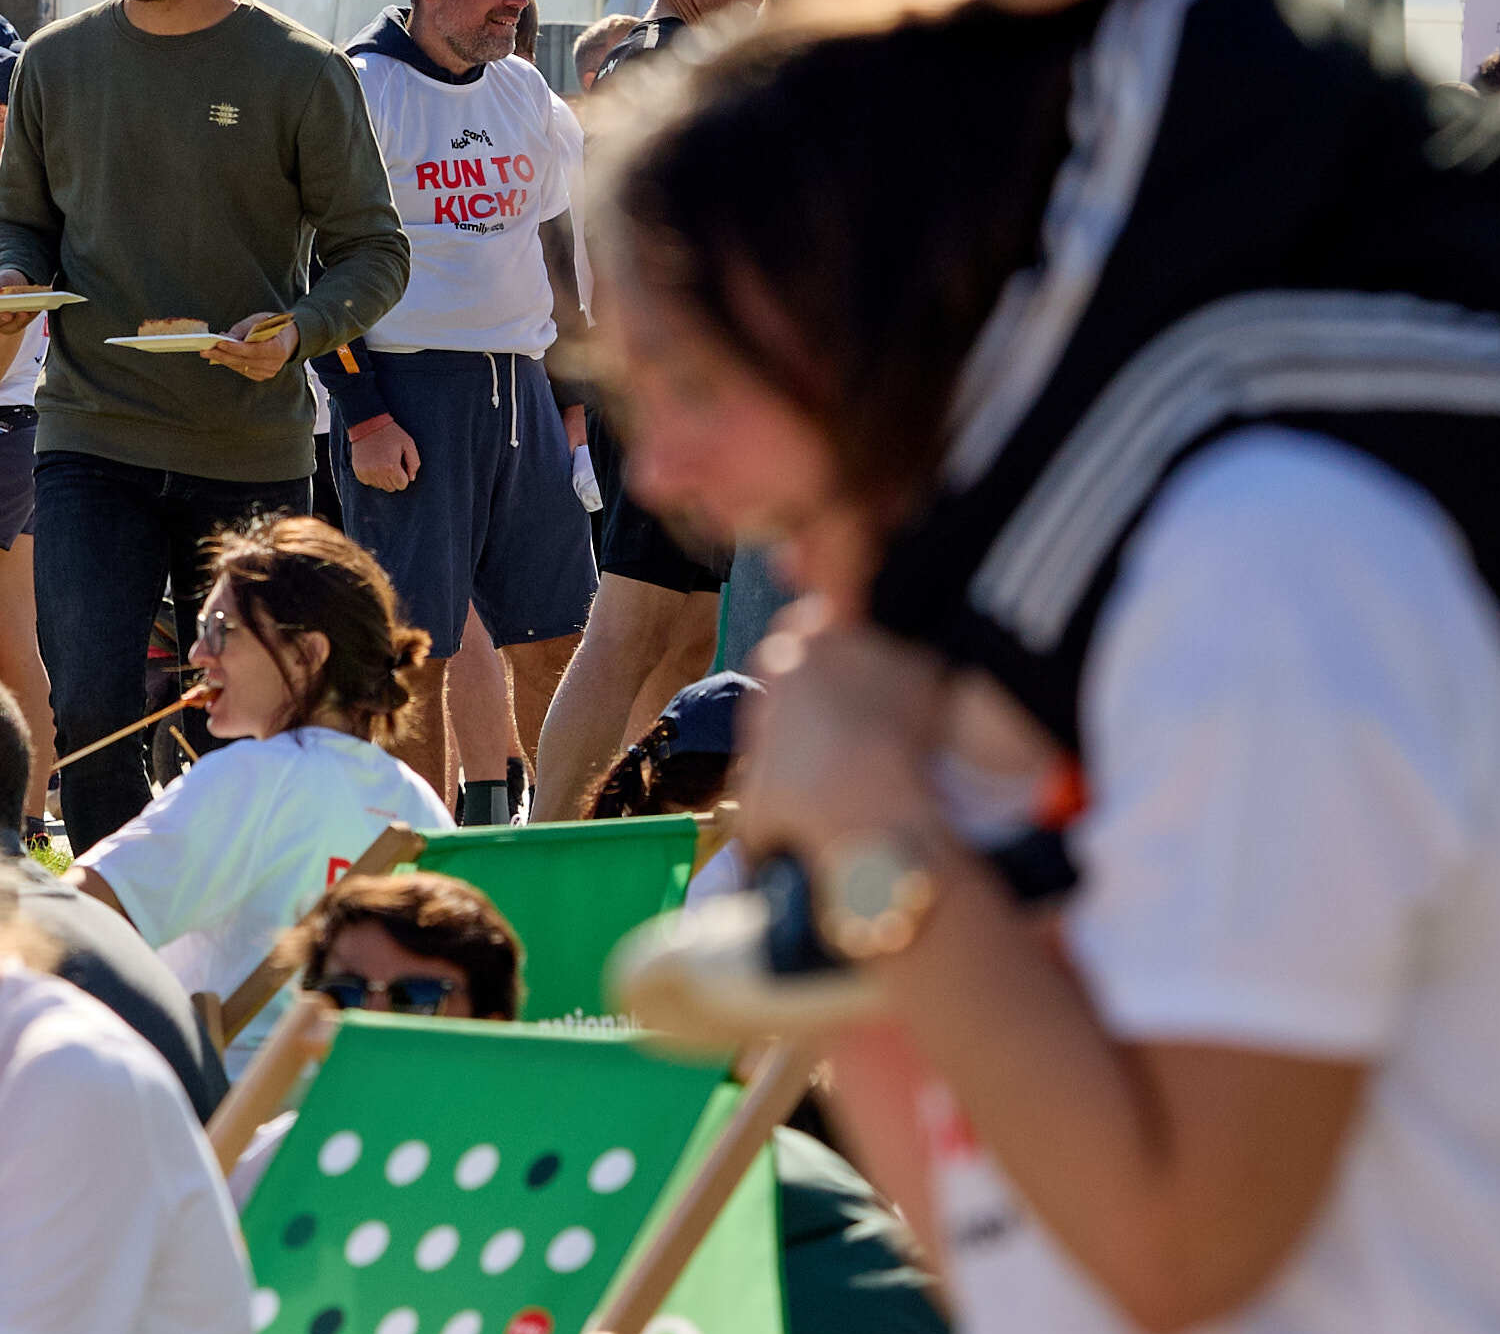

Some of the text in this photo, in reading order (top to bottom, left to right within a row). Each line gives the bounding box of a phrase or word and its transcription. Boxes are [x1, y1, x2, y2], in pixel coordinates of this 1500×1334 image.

[415, 153, 535, 191] RUN TO
[434, 187, 528, 225] KICK!
